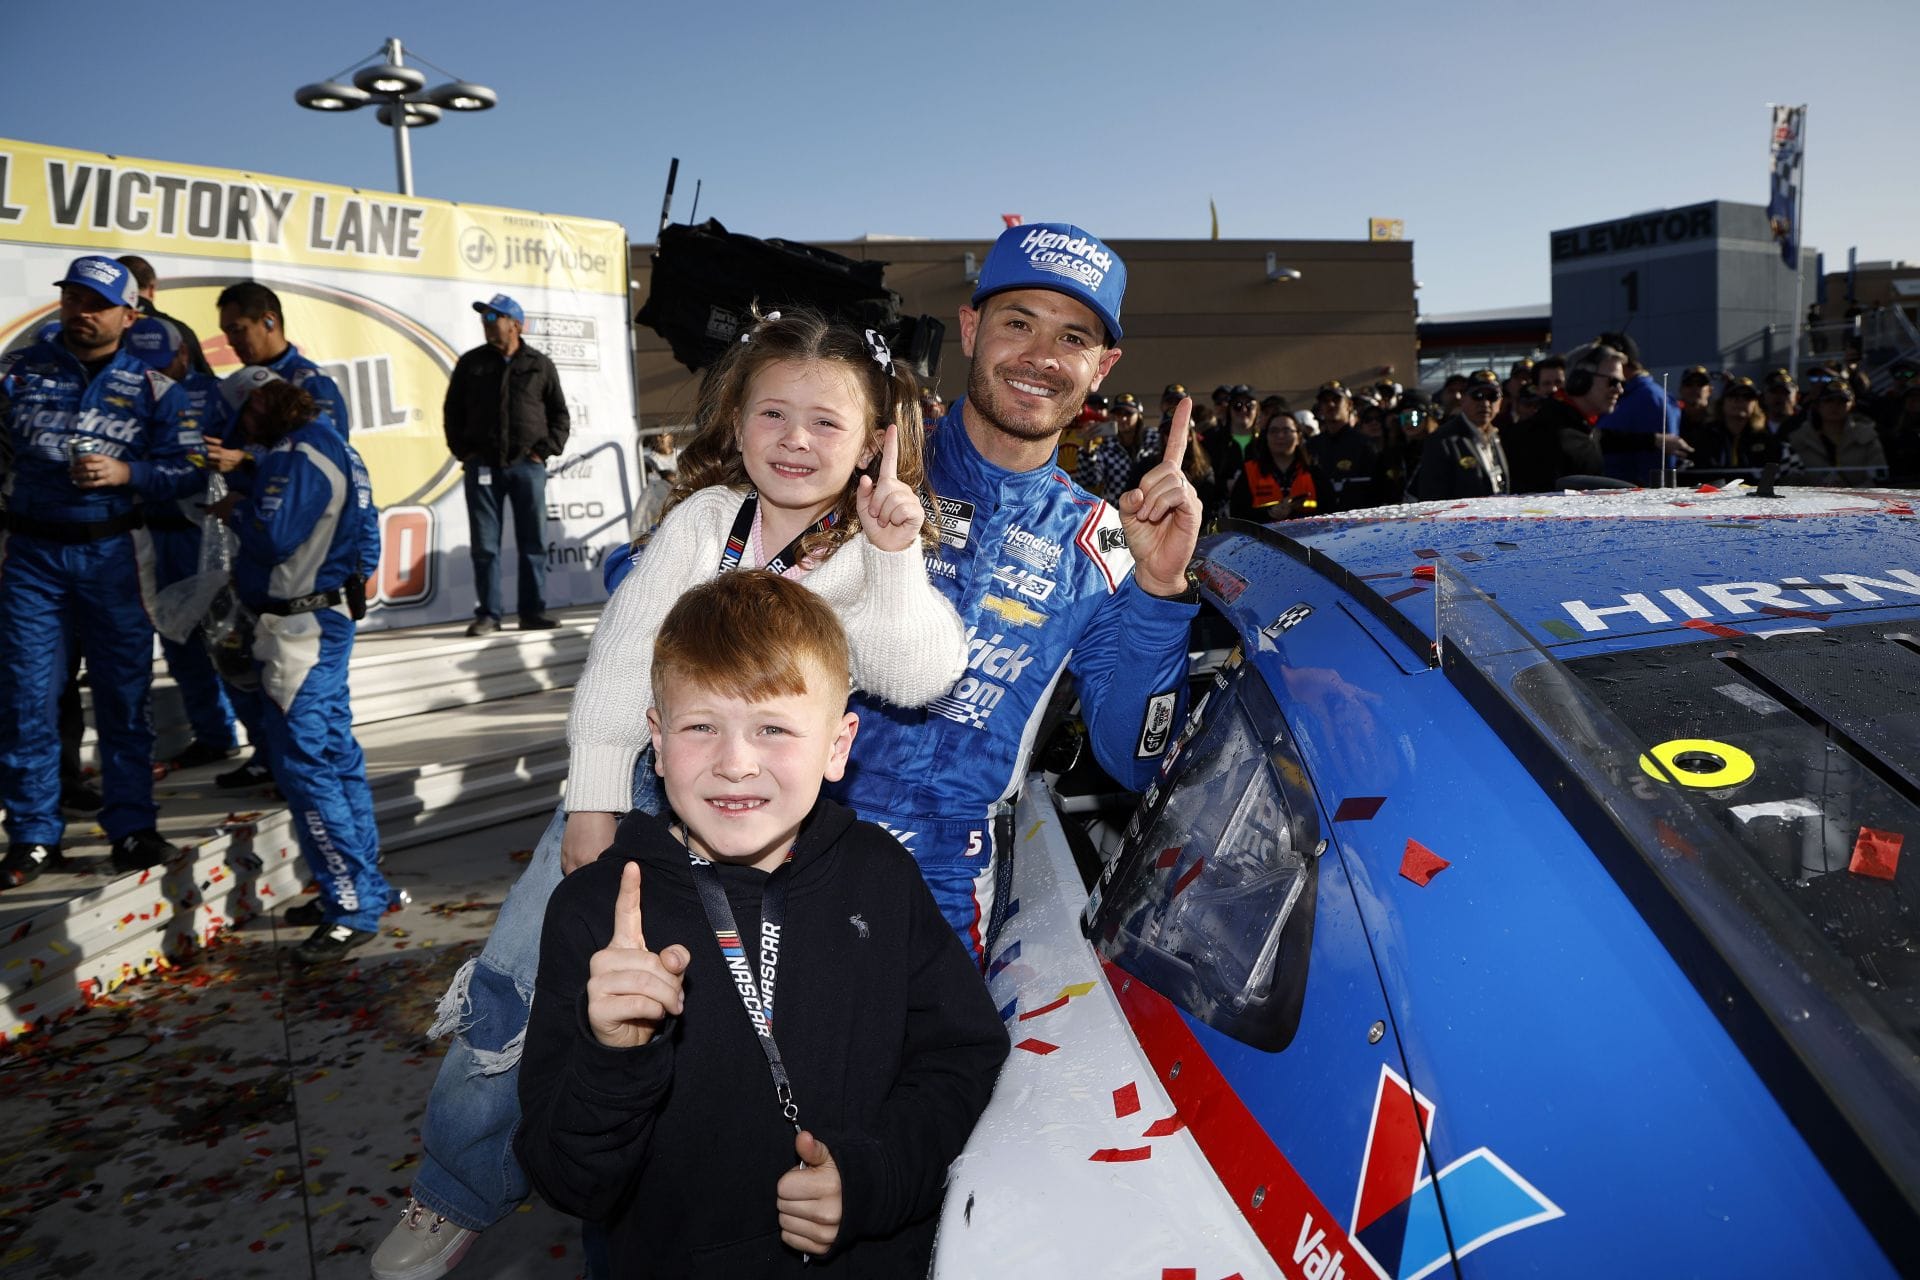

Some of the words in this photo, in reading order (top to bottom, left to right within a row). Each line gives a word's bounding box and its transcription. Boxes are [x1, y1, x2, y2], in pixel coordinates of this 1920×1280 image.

[48, 162, 294, 244] VICTORY
[311, 196, 424, 258] LANE
[1020, 229, 1112, 272] Hendrick
[1553, 208, 1712, 256] ELEVATOR
[1030, 248, 1104, 283] Cars.com
[1621, 271, 1639, 312] 1
[1003, 523, 1064, 559] Hendrick
[964, 830, 983, 857] 5
[760, 921, 781, 1010] NASCAR
[726, 956, 771, 1038] NASCAR
